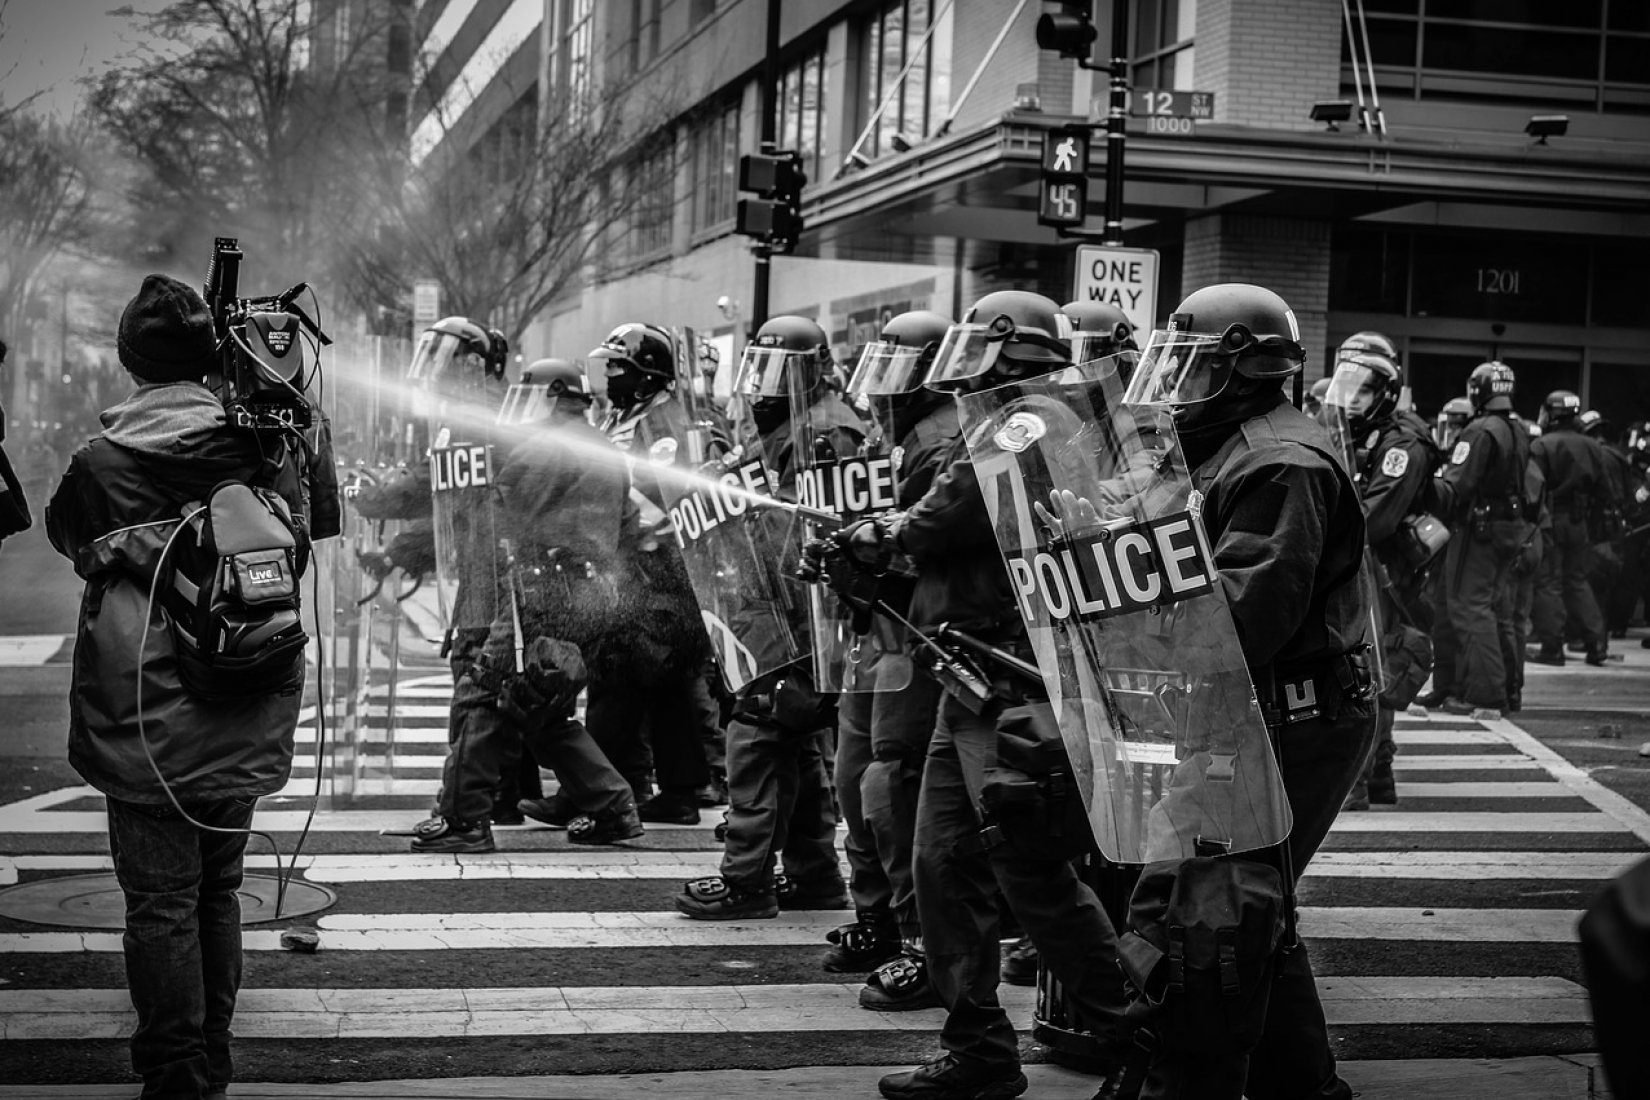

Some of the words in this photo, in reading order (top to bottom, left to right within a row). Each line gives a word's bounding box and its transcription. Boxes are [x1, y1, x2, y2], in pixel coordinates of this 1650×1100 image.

[1142, 91, 1173, 115] 12
[1191, 93, 1208, 106] ST
[1190, 106, 1211, 116] NW
[1150, 117, 1192, 133] 1000
[1050, 184, 1077, 218] 45
[1092, 260, 1142, 283] ONE
[1478, 269, 1519, 294] 1201
[1089, 286, 1142, 310] WAY
[430, 446, 487, 492] OLICE
[795, 459, 895, 514] POLICE
[670, 461, 771, 548] POLICE
[1009, 519, 1207, 621] POLICE
